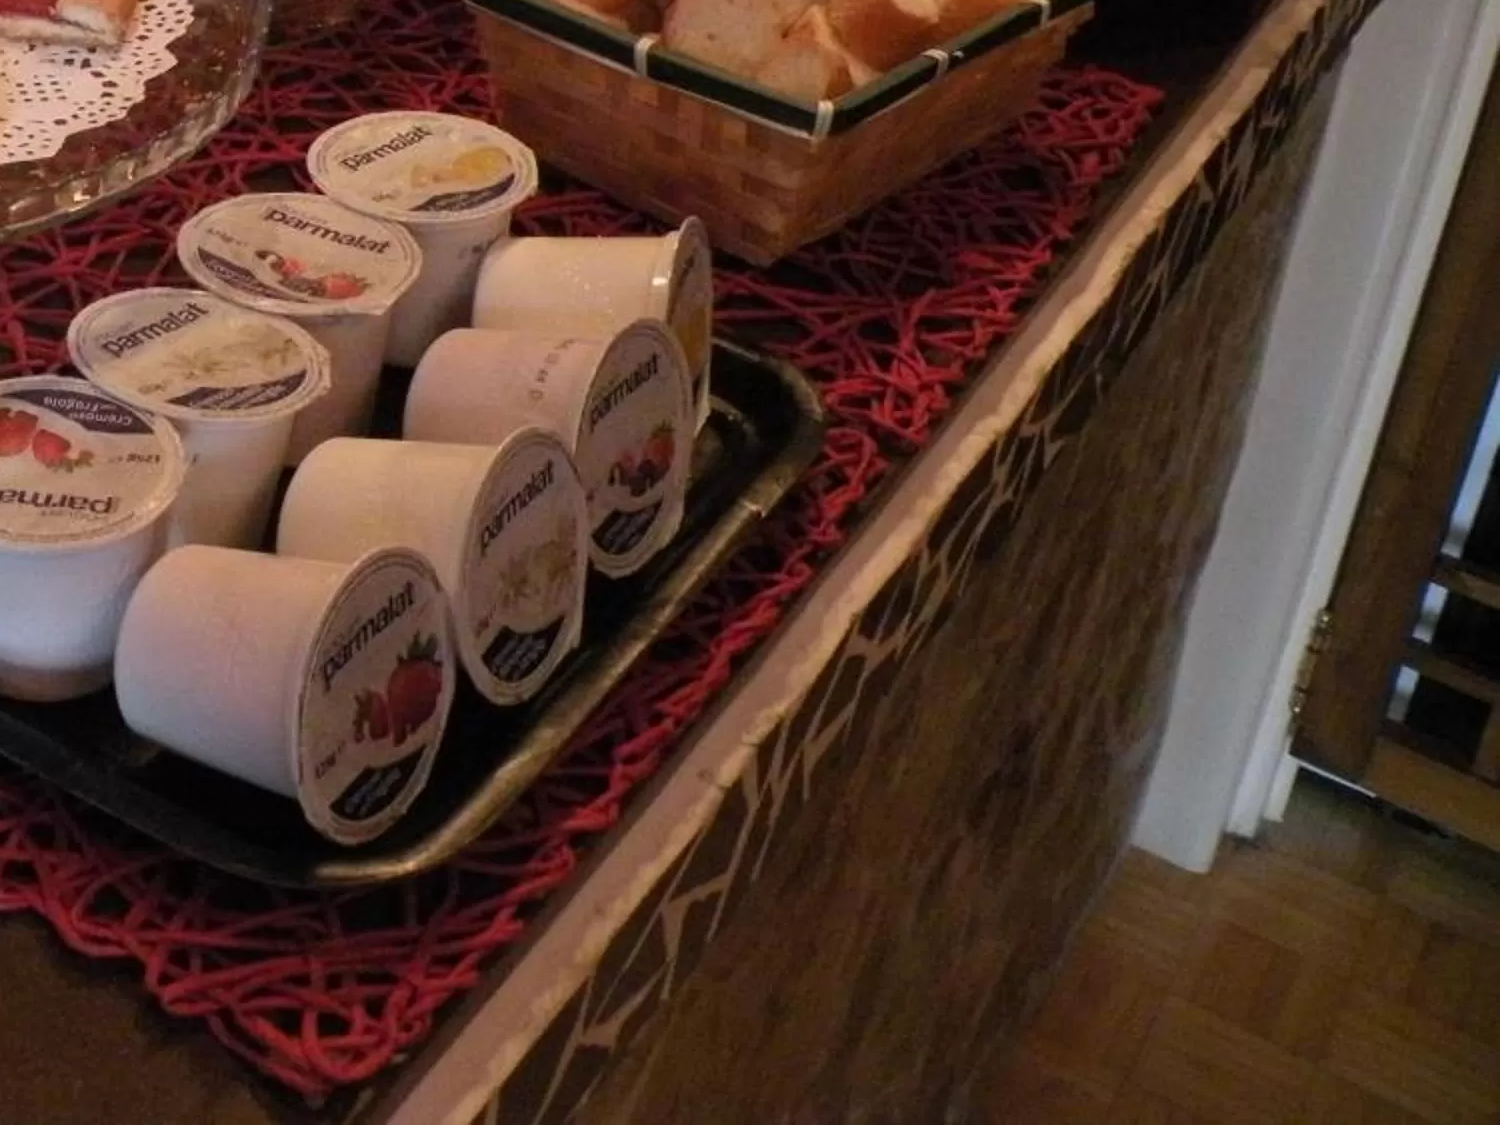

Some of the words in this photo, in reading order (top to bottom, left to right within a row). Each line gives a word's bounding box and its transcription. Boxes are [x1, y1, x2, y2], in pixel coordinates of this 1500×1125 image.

[340, 125, 431, 171] parmalat
[264, 208, 391, 254] parmalat
[102, 302, 209, 358] parmalat
[588, 353, 658, 433] parmalat
[480, 459, 553, 557] parmalat
[320, 580, 415, 693] parmalat
